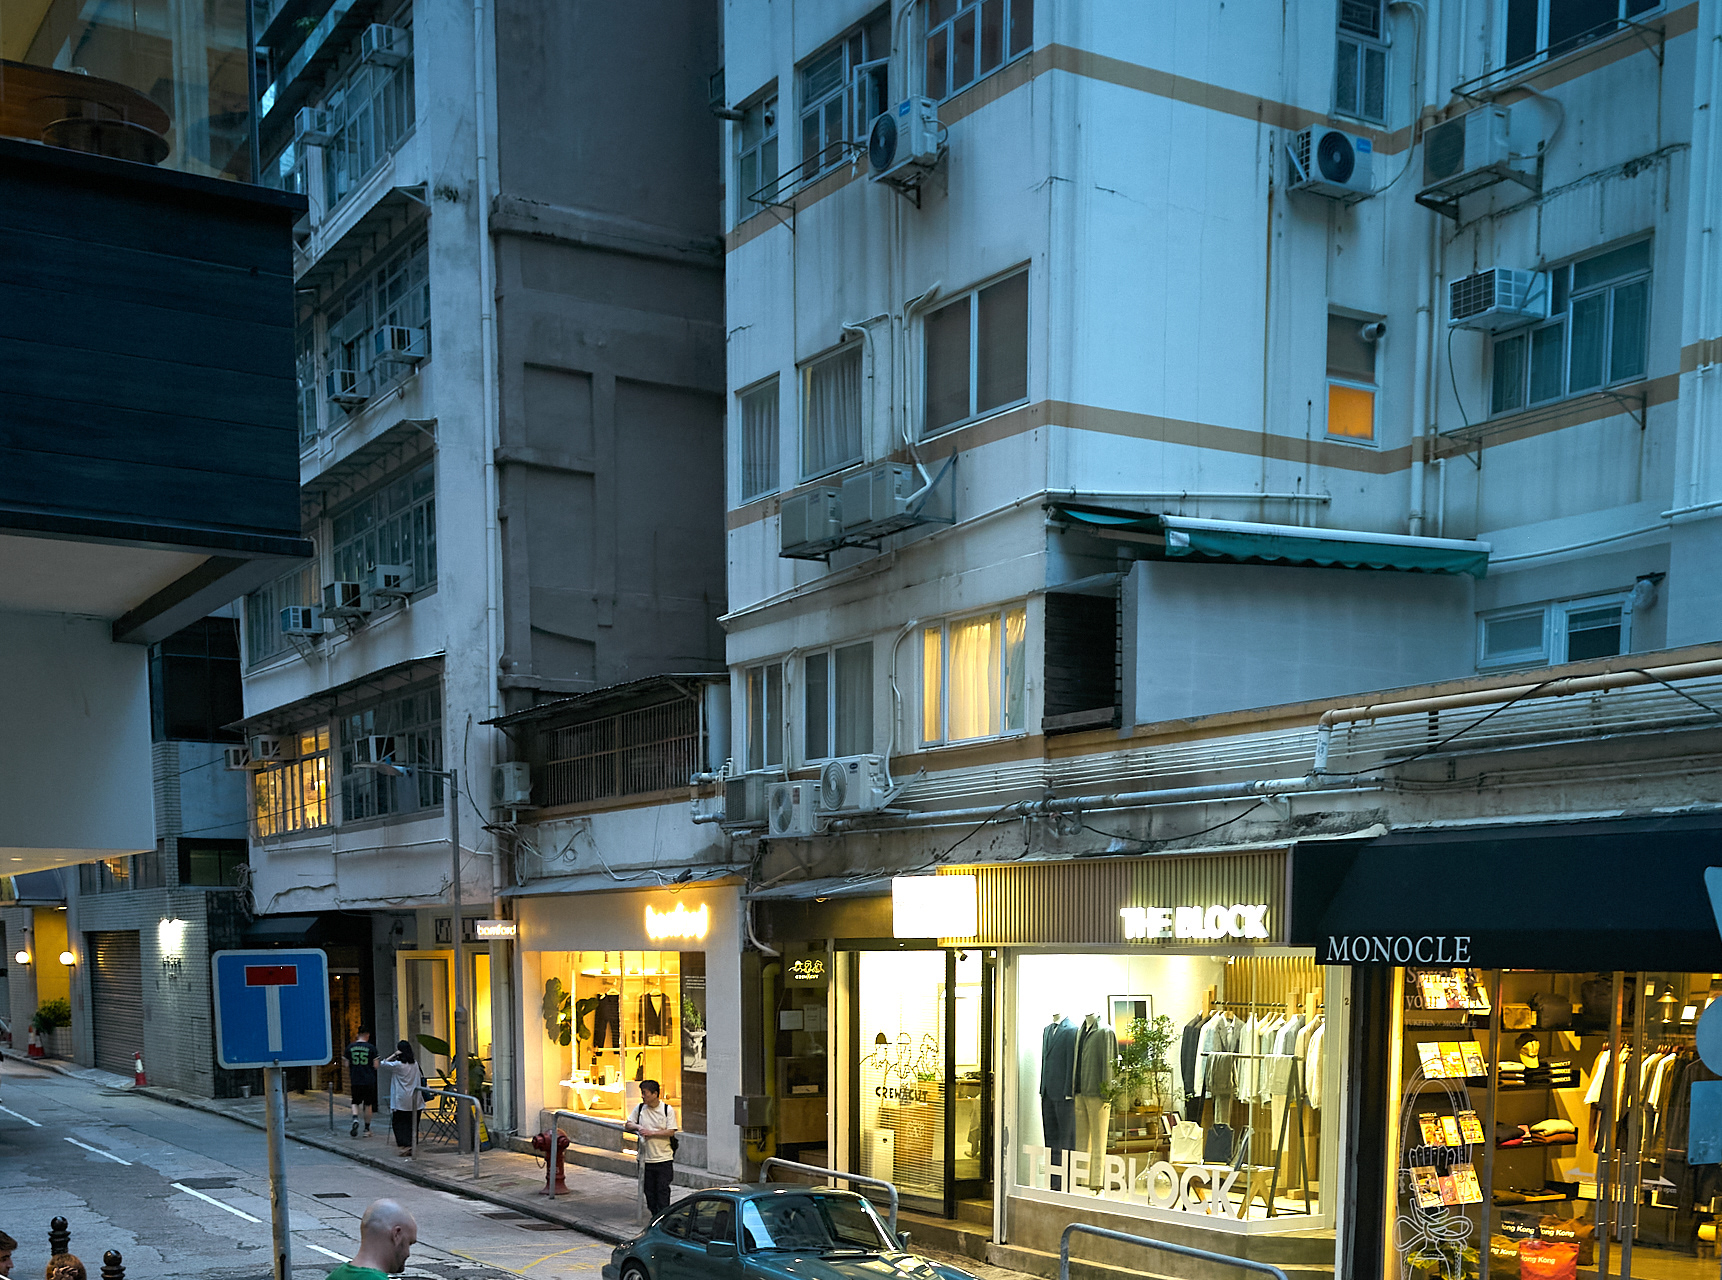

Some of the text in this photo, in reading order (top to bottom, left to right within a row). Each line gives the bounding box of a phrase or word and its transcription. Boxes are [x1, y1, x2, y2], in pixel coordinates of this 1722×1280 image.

[1120, 904, 1270, 940] THE BLOCK
[476, 924, 517, 936] bamford
[1326, 936, 1471, 963] MONOCLE
[351, 1051, 369, 1066] 55
[1022, 1144, 1241, 1219] THE BLOCK
[1517, 1225, 1535, 1235] Kong
[1556, 1229, 1575, 1238] Kong
[1500, 1248, 1518, 1256] Kong
[1538, 1256, 1556, 1265] Kong
